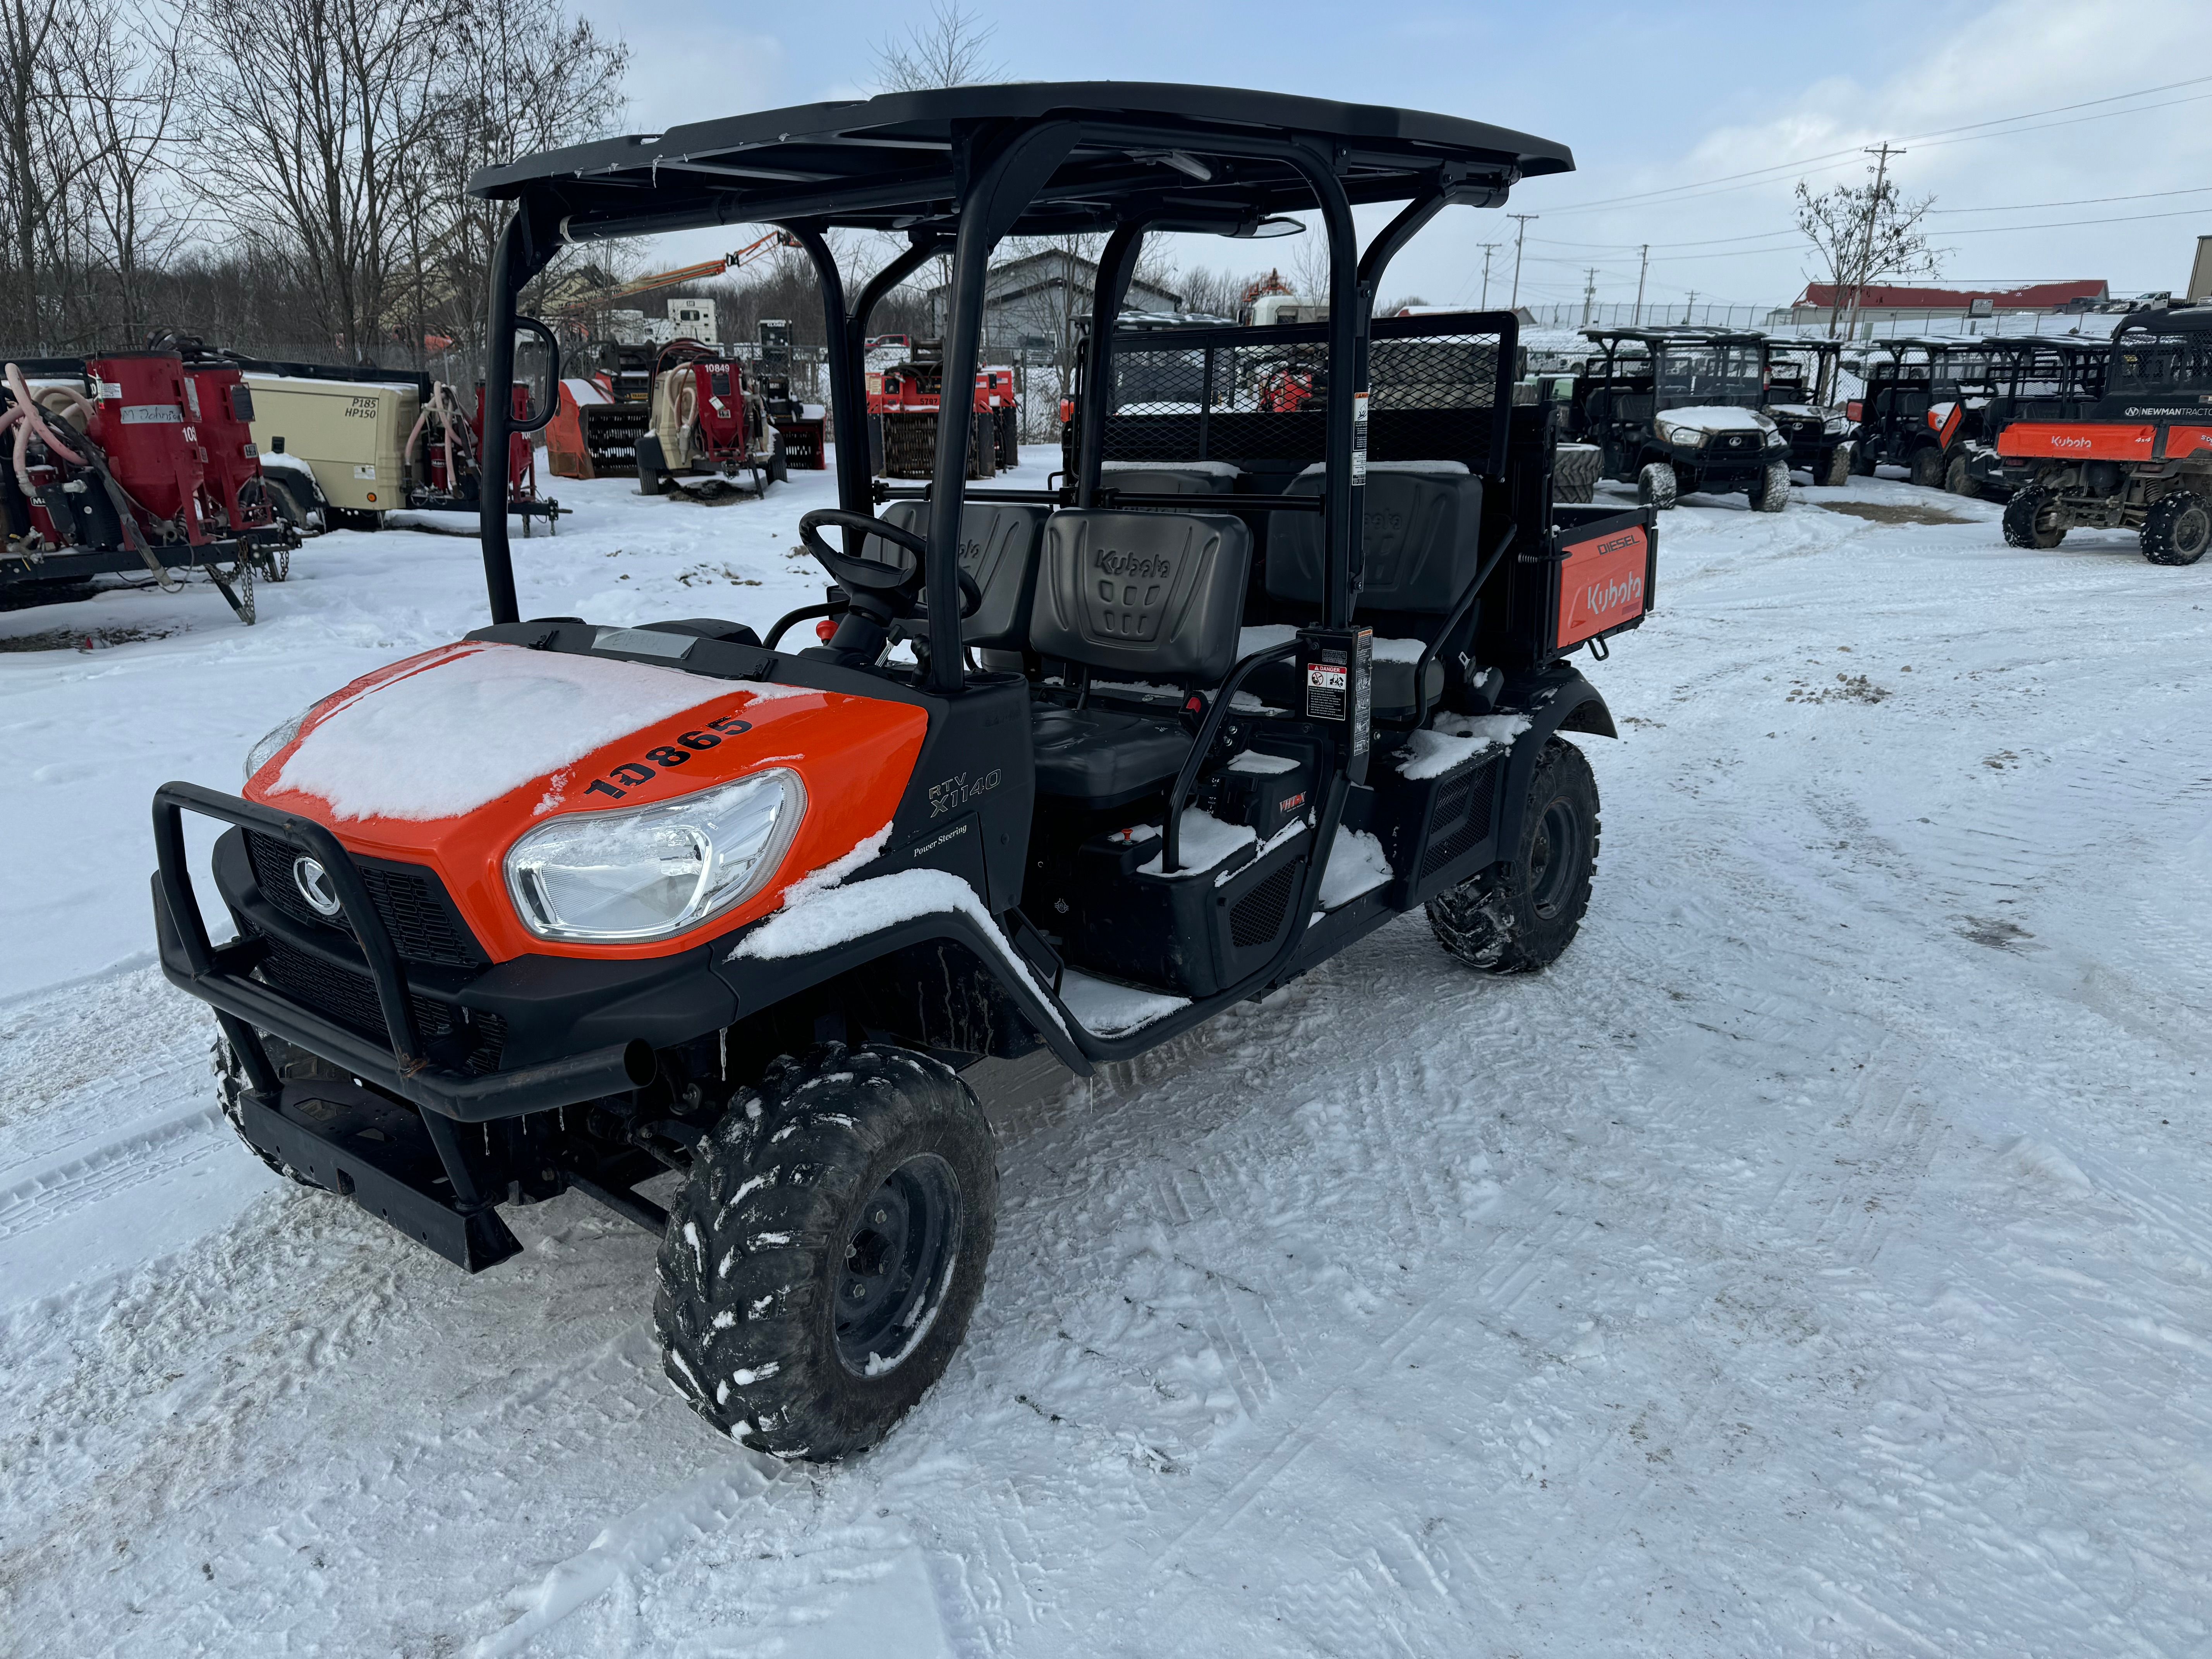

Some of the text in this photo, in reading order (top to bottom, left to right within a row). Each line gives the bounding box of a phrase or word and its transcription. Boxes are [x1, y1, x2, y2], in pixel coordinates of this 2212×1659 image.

[705, 364, 730, 373] 10849
[122, 410, 134, 420] M
[345, 408, 376, 419] HP150
[352, 398, 376, 408] P185
[2051, 436, 2092, 448] Kubota
[1597, 534, 1640, 555] DIESEL
[1095, 549, 1170, 578] Kubota
[1587, 571, 1641, 615] Kubota
[583, 716, 752, 799] 10865
[929, 772, 967, 800] RTV
[930, 769, 1001, 818] X1140
[914, 825, 967, 857] Power Steering
